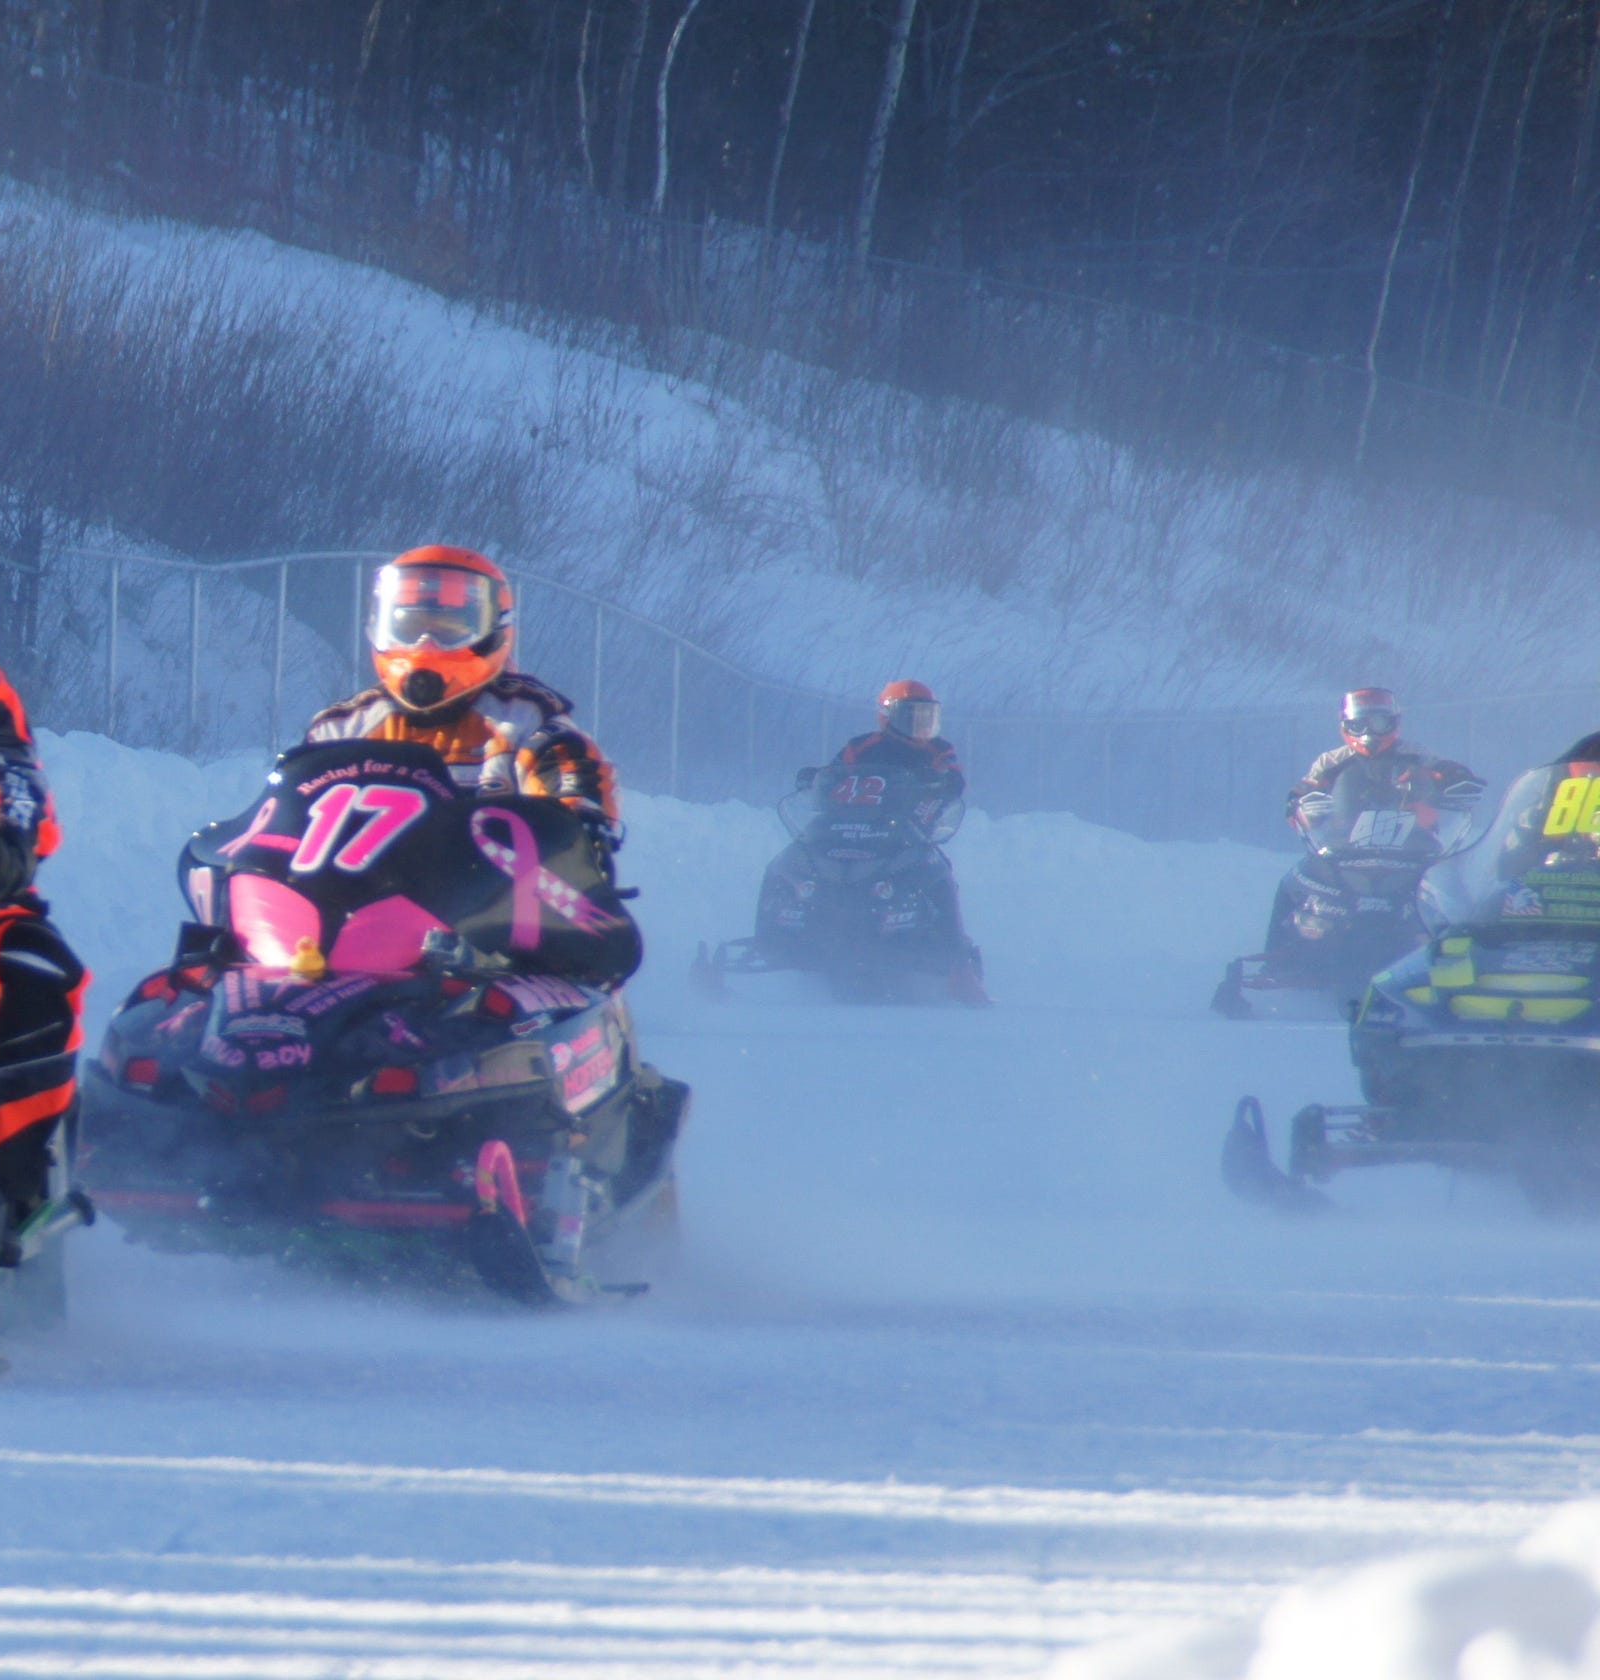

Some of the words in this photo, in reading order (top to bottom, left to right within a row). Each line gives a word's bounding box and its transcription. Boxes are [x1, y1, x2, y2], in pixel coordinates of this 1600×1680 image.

[295, 763, 360, 796] Racing
[363, 759, 394, 774] for
[830, 775, 886, 805] 42
[290, 783, 428, 873] 17
